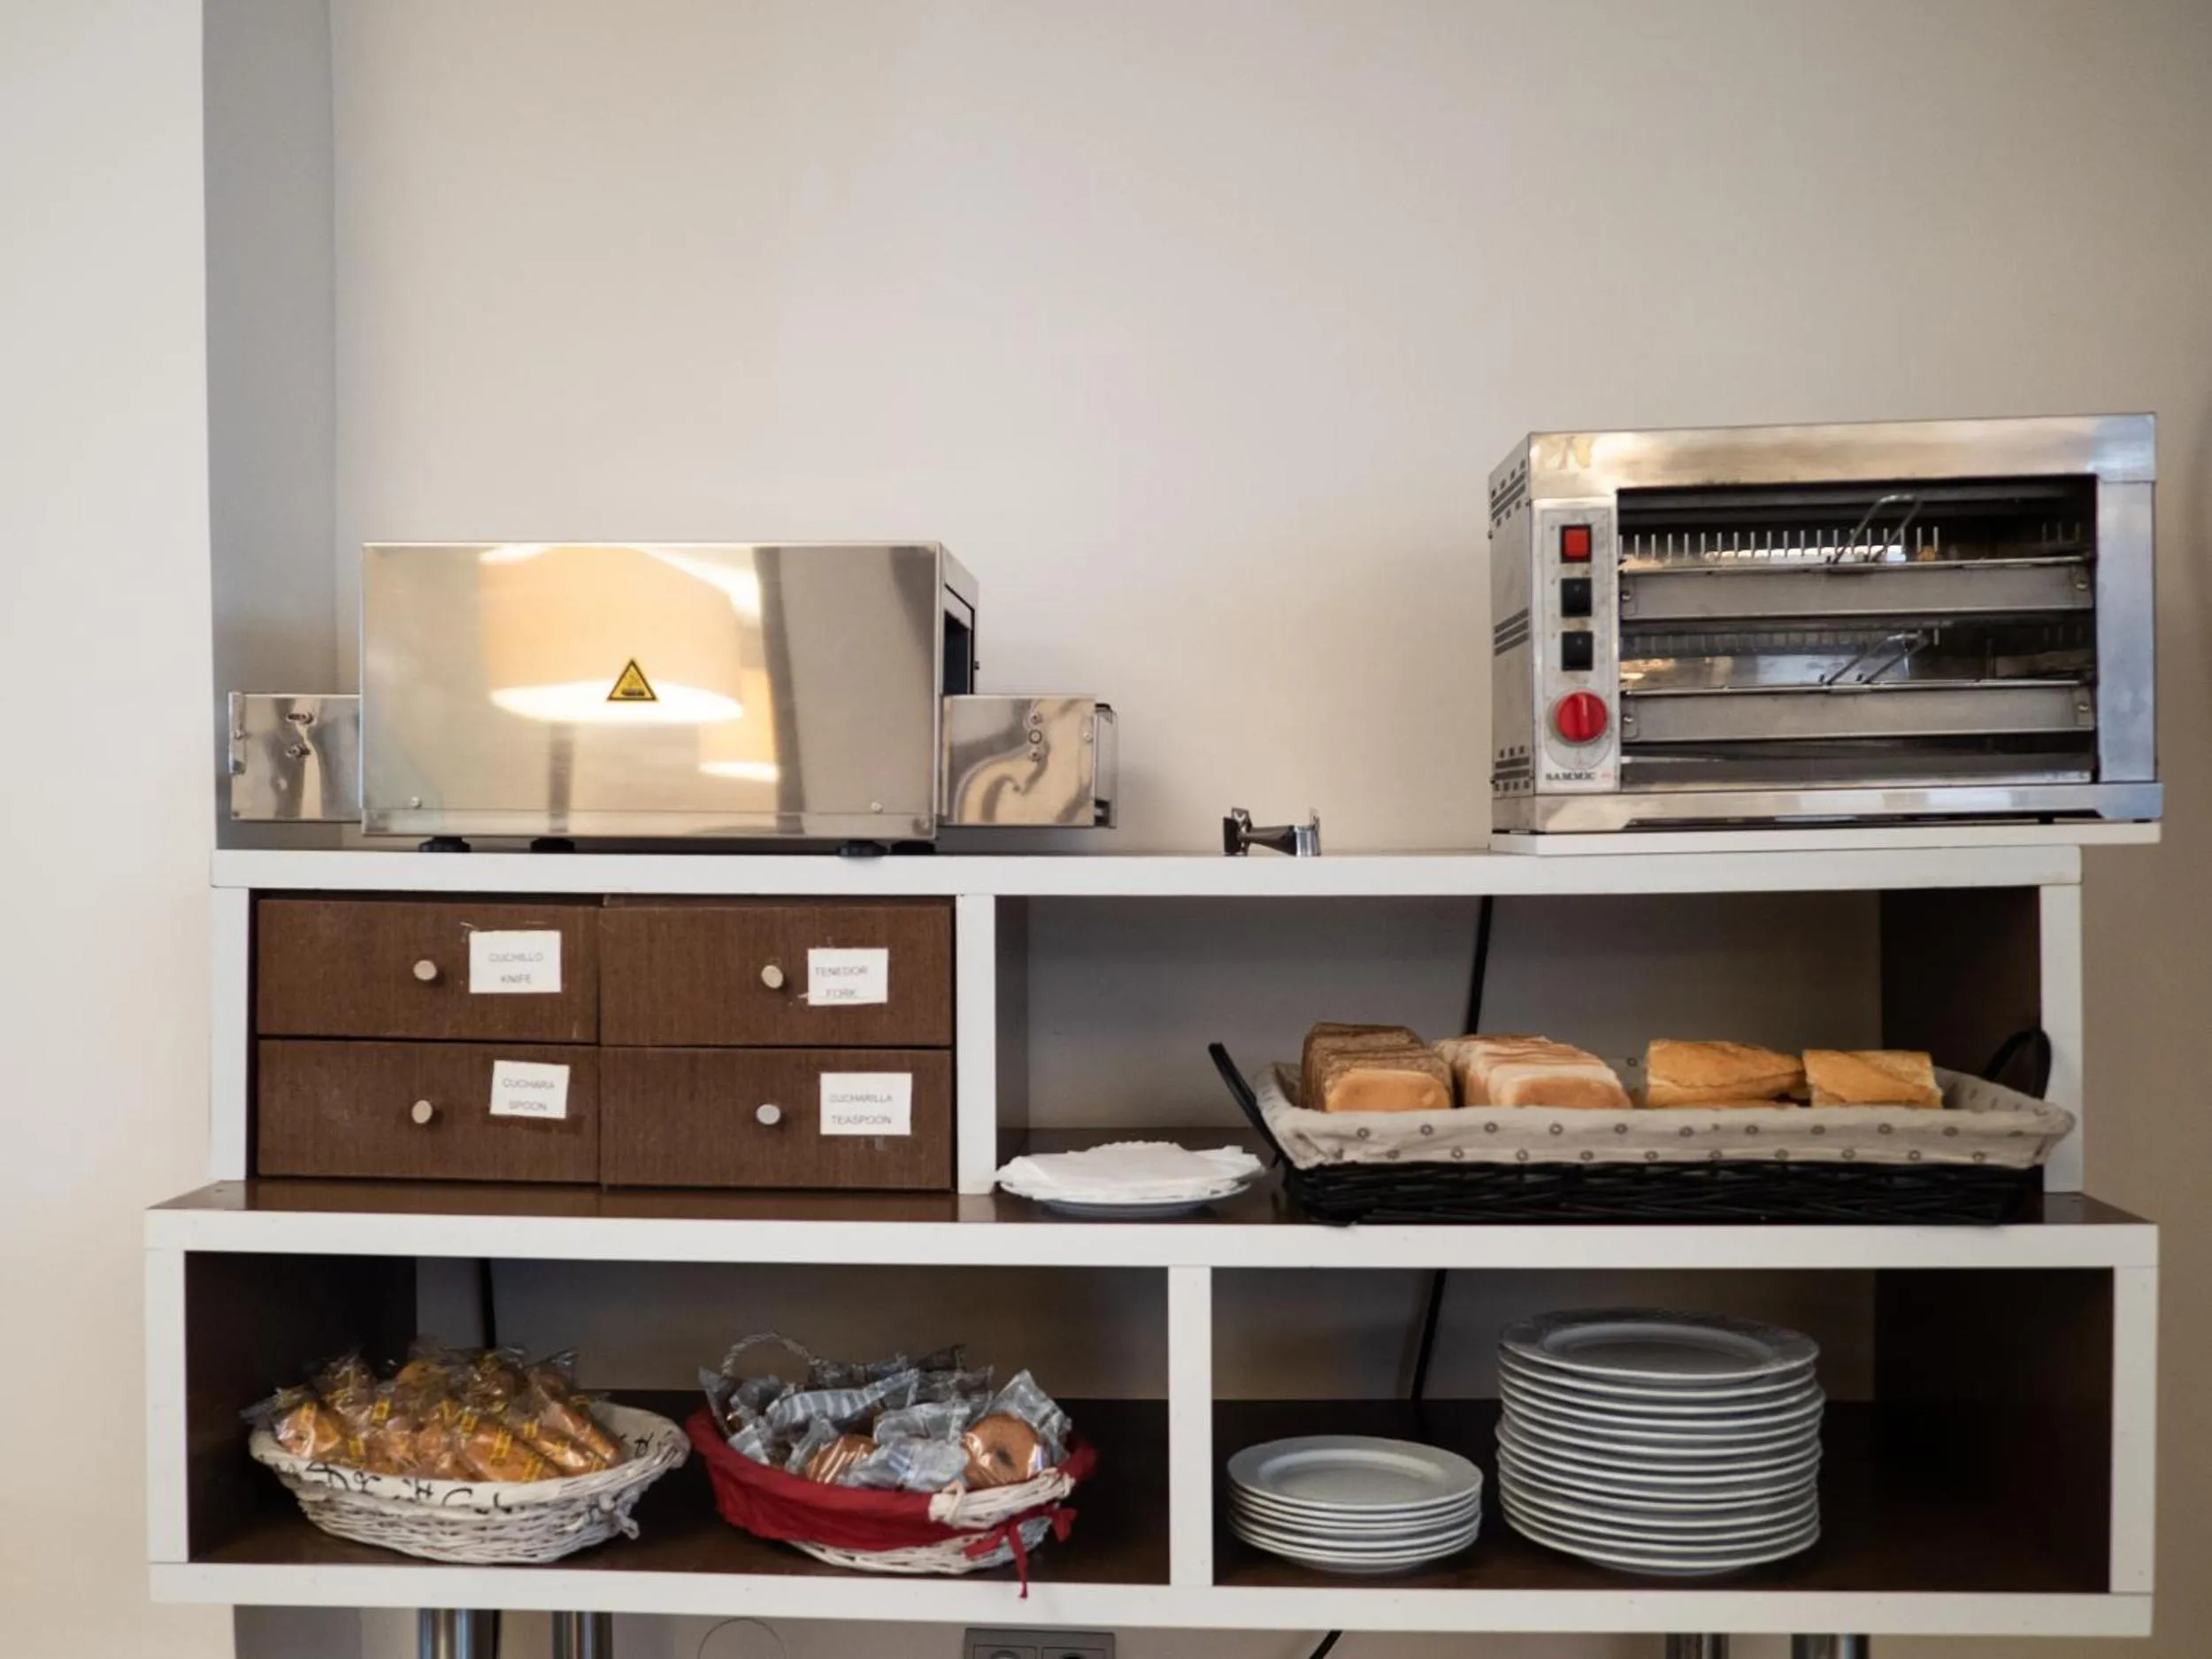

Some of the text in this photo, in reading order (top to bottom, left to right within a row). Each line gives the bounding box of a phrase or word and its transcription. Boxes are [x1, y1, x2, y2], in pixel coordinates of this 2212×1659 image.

[814, 965, 870, 977] TENEDOR
[501, 974, 532, 984] KNIFE
[509, 1101, 548, 1111] SPOON
[831, 1115, 892, 1125] TEASPOON
